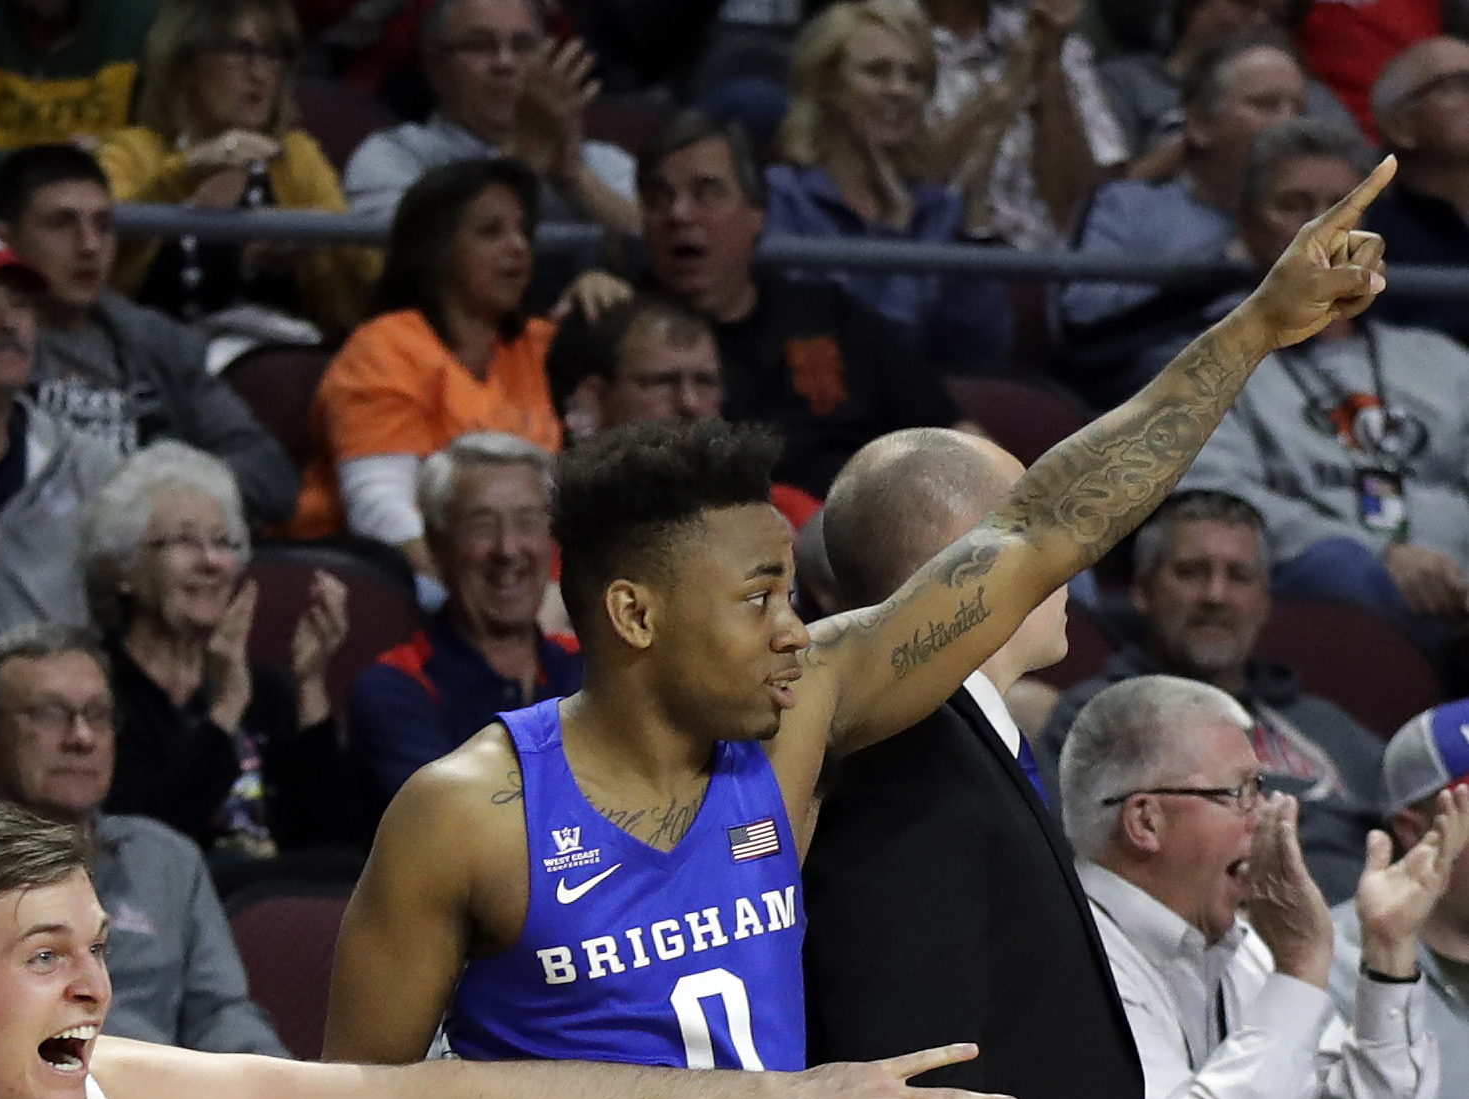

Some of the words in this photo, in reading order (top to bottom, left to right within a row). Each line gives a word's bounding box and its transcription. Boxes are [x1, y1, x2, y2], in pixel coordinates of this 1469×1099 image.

[544, 856, 571, 867] WEST
[571, 848, 601, 862] COAST
[537, 885, 797, 984] BRIGHAM
